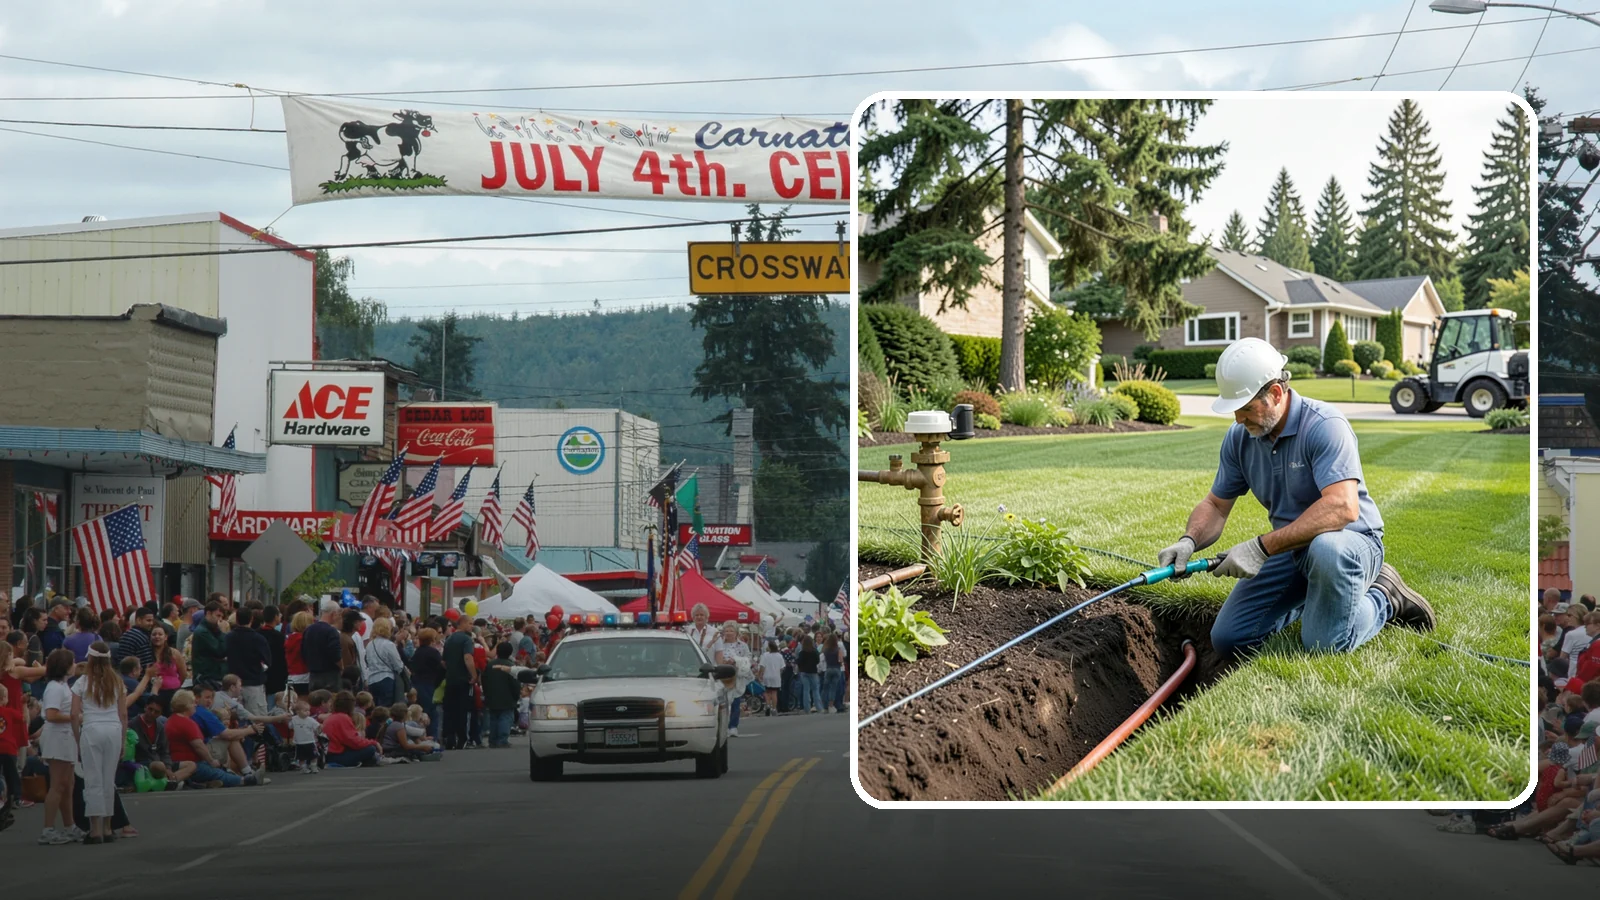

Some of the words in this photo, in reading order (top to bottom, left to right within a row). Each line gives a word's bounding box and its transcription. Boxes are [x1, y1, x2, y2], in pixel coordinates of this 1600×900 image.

[481, 141, 604, 192] JULY
[632, 150, 746, 197] 4th.
[697, 254, 850, 280] CROSSWA
[283, 380, 373, 419] ACE
[406, 409, 453, 422] CEDAR
[461, 409, 485, 421] LOG
[283, 421, 371, 436] Hardware
[416, 428, 477, 446] Coca-Cola
[353, 467, 385, 479] Simpl
[83, 485, 93, 494] St.
[96, 485, 124, 494] Vincent
[126, 486, 135, 494] de
[137, 486, 155, 495] Paul
[213, 516, 331, 535] HARDARE
[688, 527, 741, 535] CRNATION
[699, 535, 730, 543] GLASS
